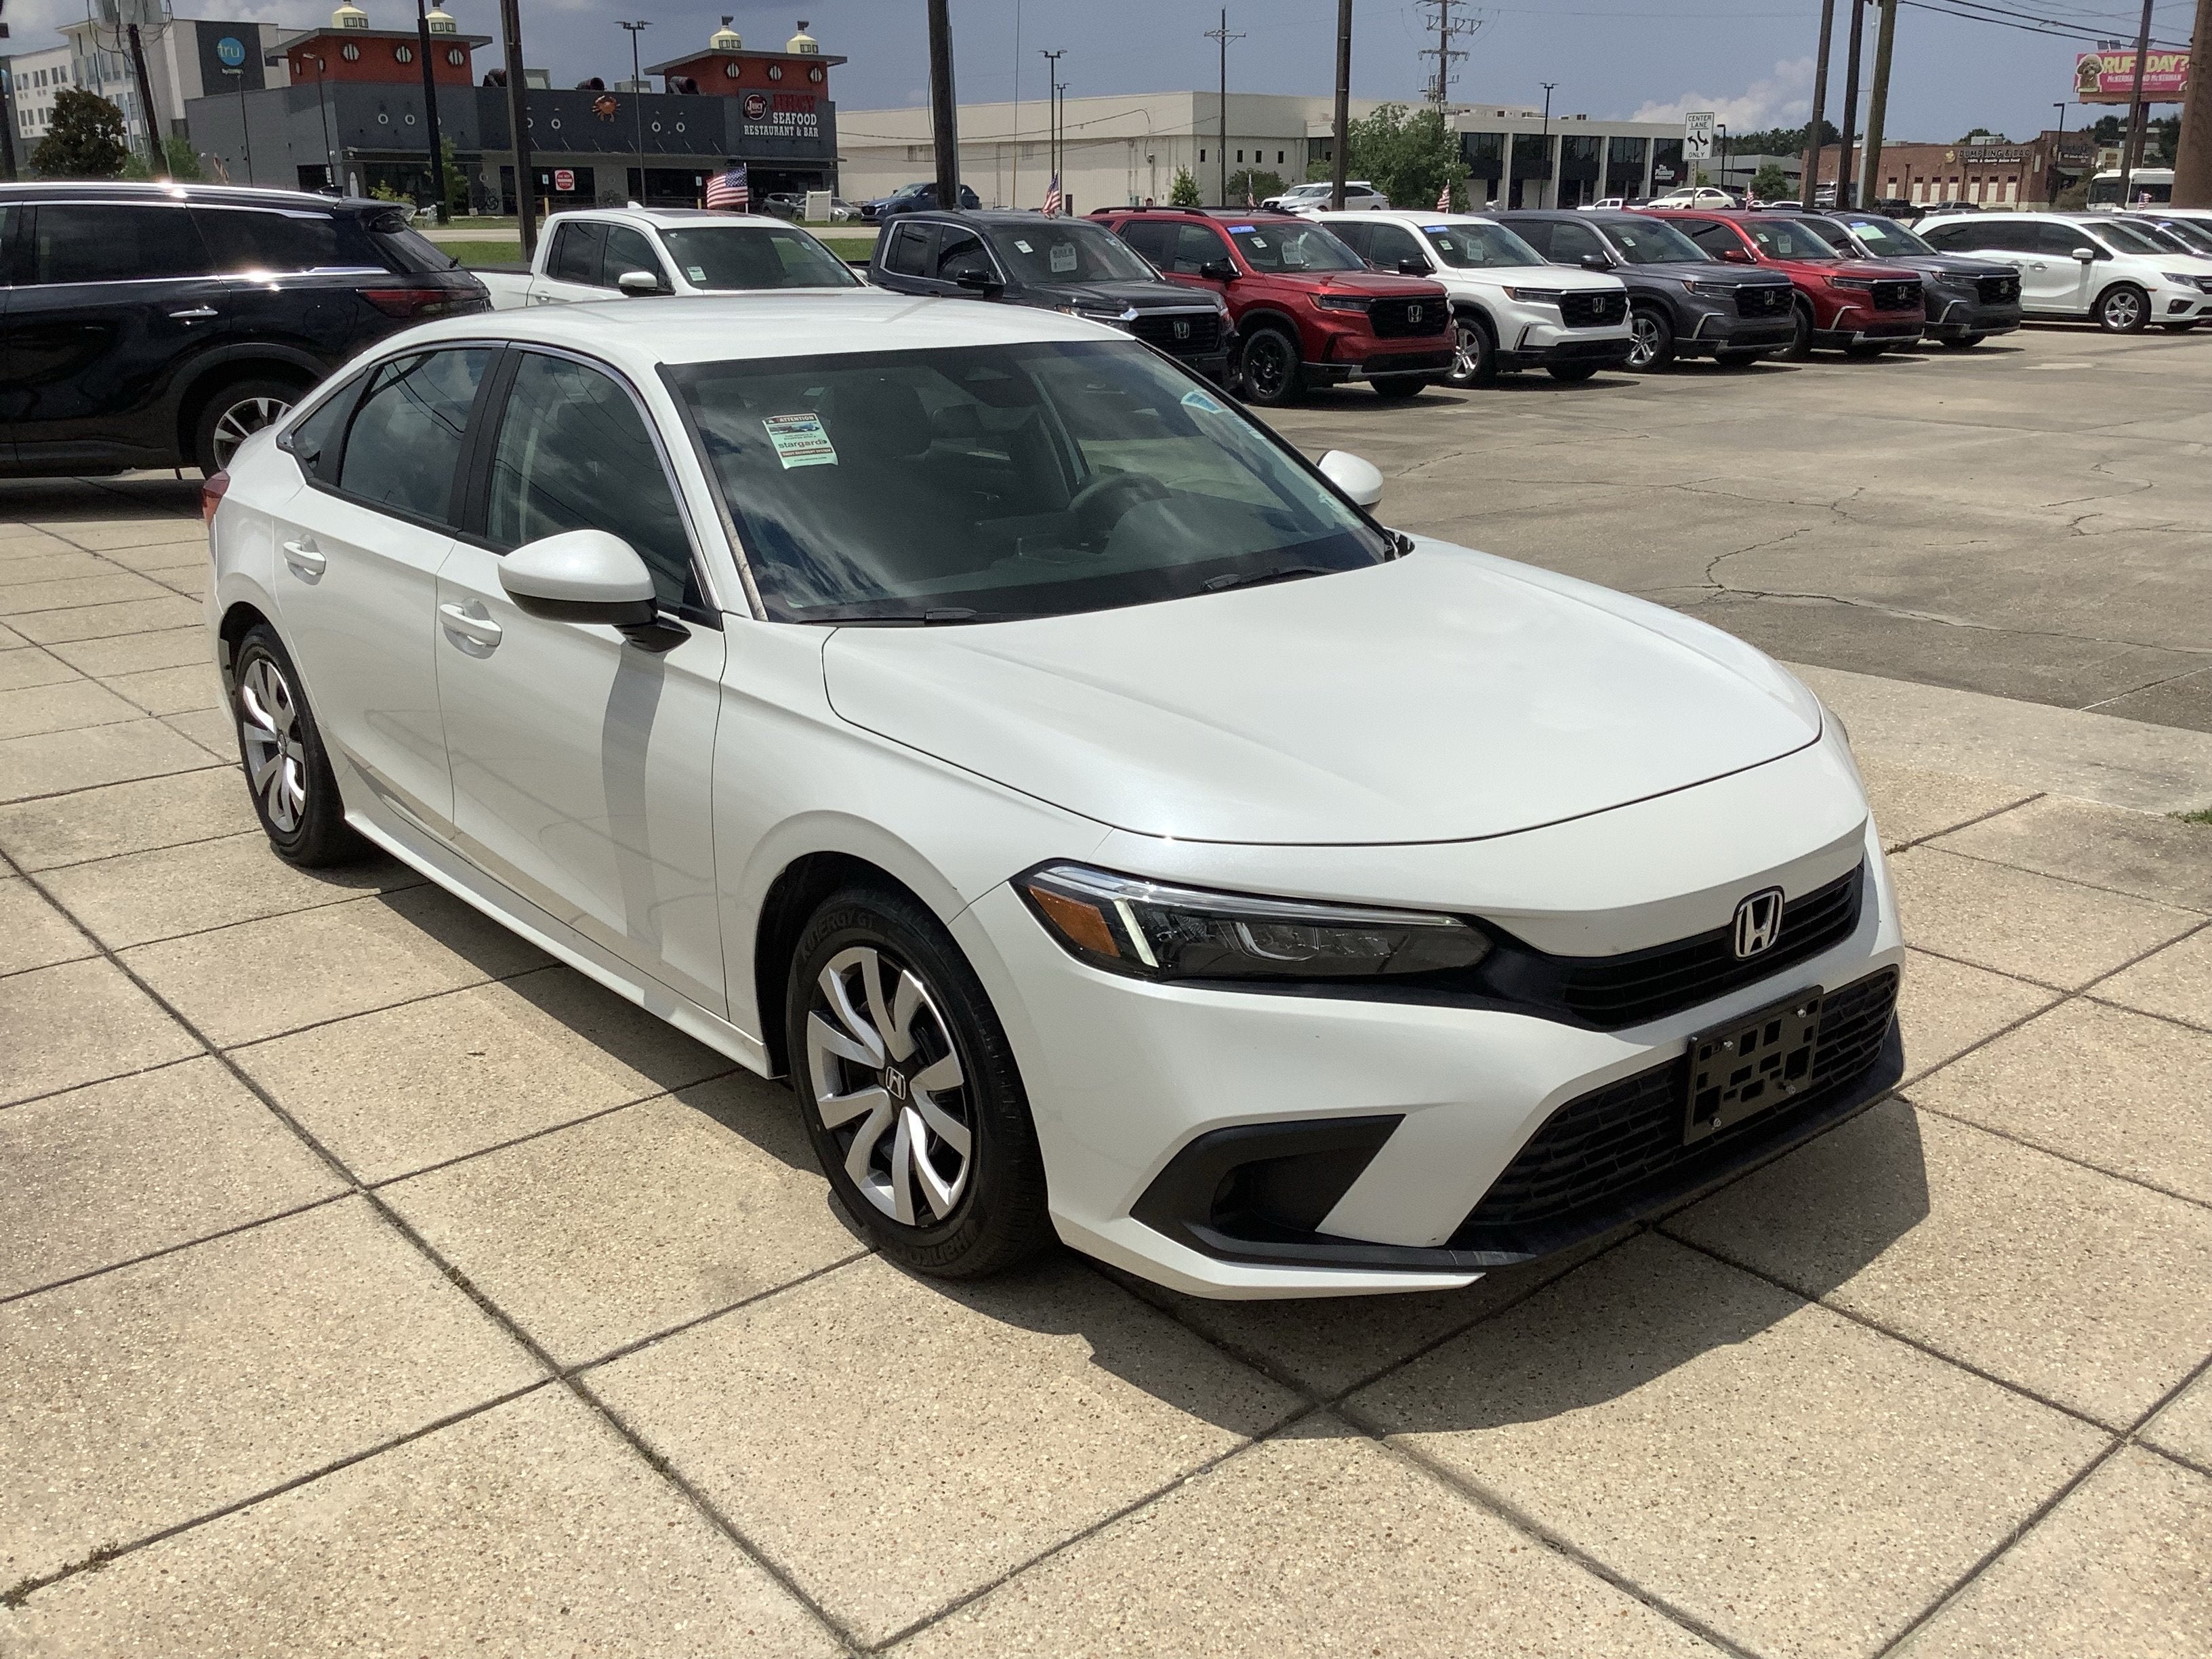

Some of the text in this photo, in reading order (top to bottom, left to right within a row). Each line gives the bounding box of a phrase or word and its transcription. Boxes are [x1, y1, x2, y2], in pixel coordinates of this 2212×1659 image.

[217, 43, 240, 58] tru
[2102, 56, 2137, 74] RUF
[773, 112, 817, 125] SEAFOOD
[743, 125, 819, 138] RESTAURANT & BAR
[779, 415, 815, 423] ATTENTION
[778, 439, 823, 449] stargard
